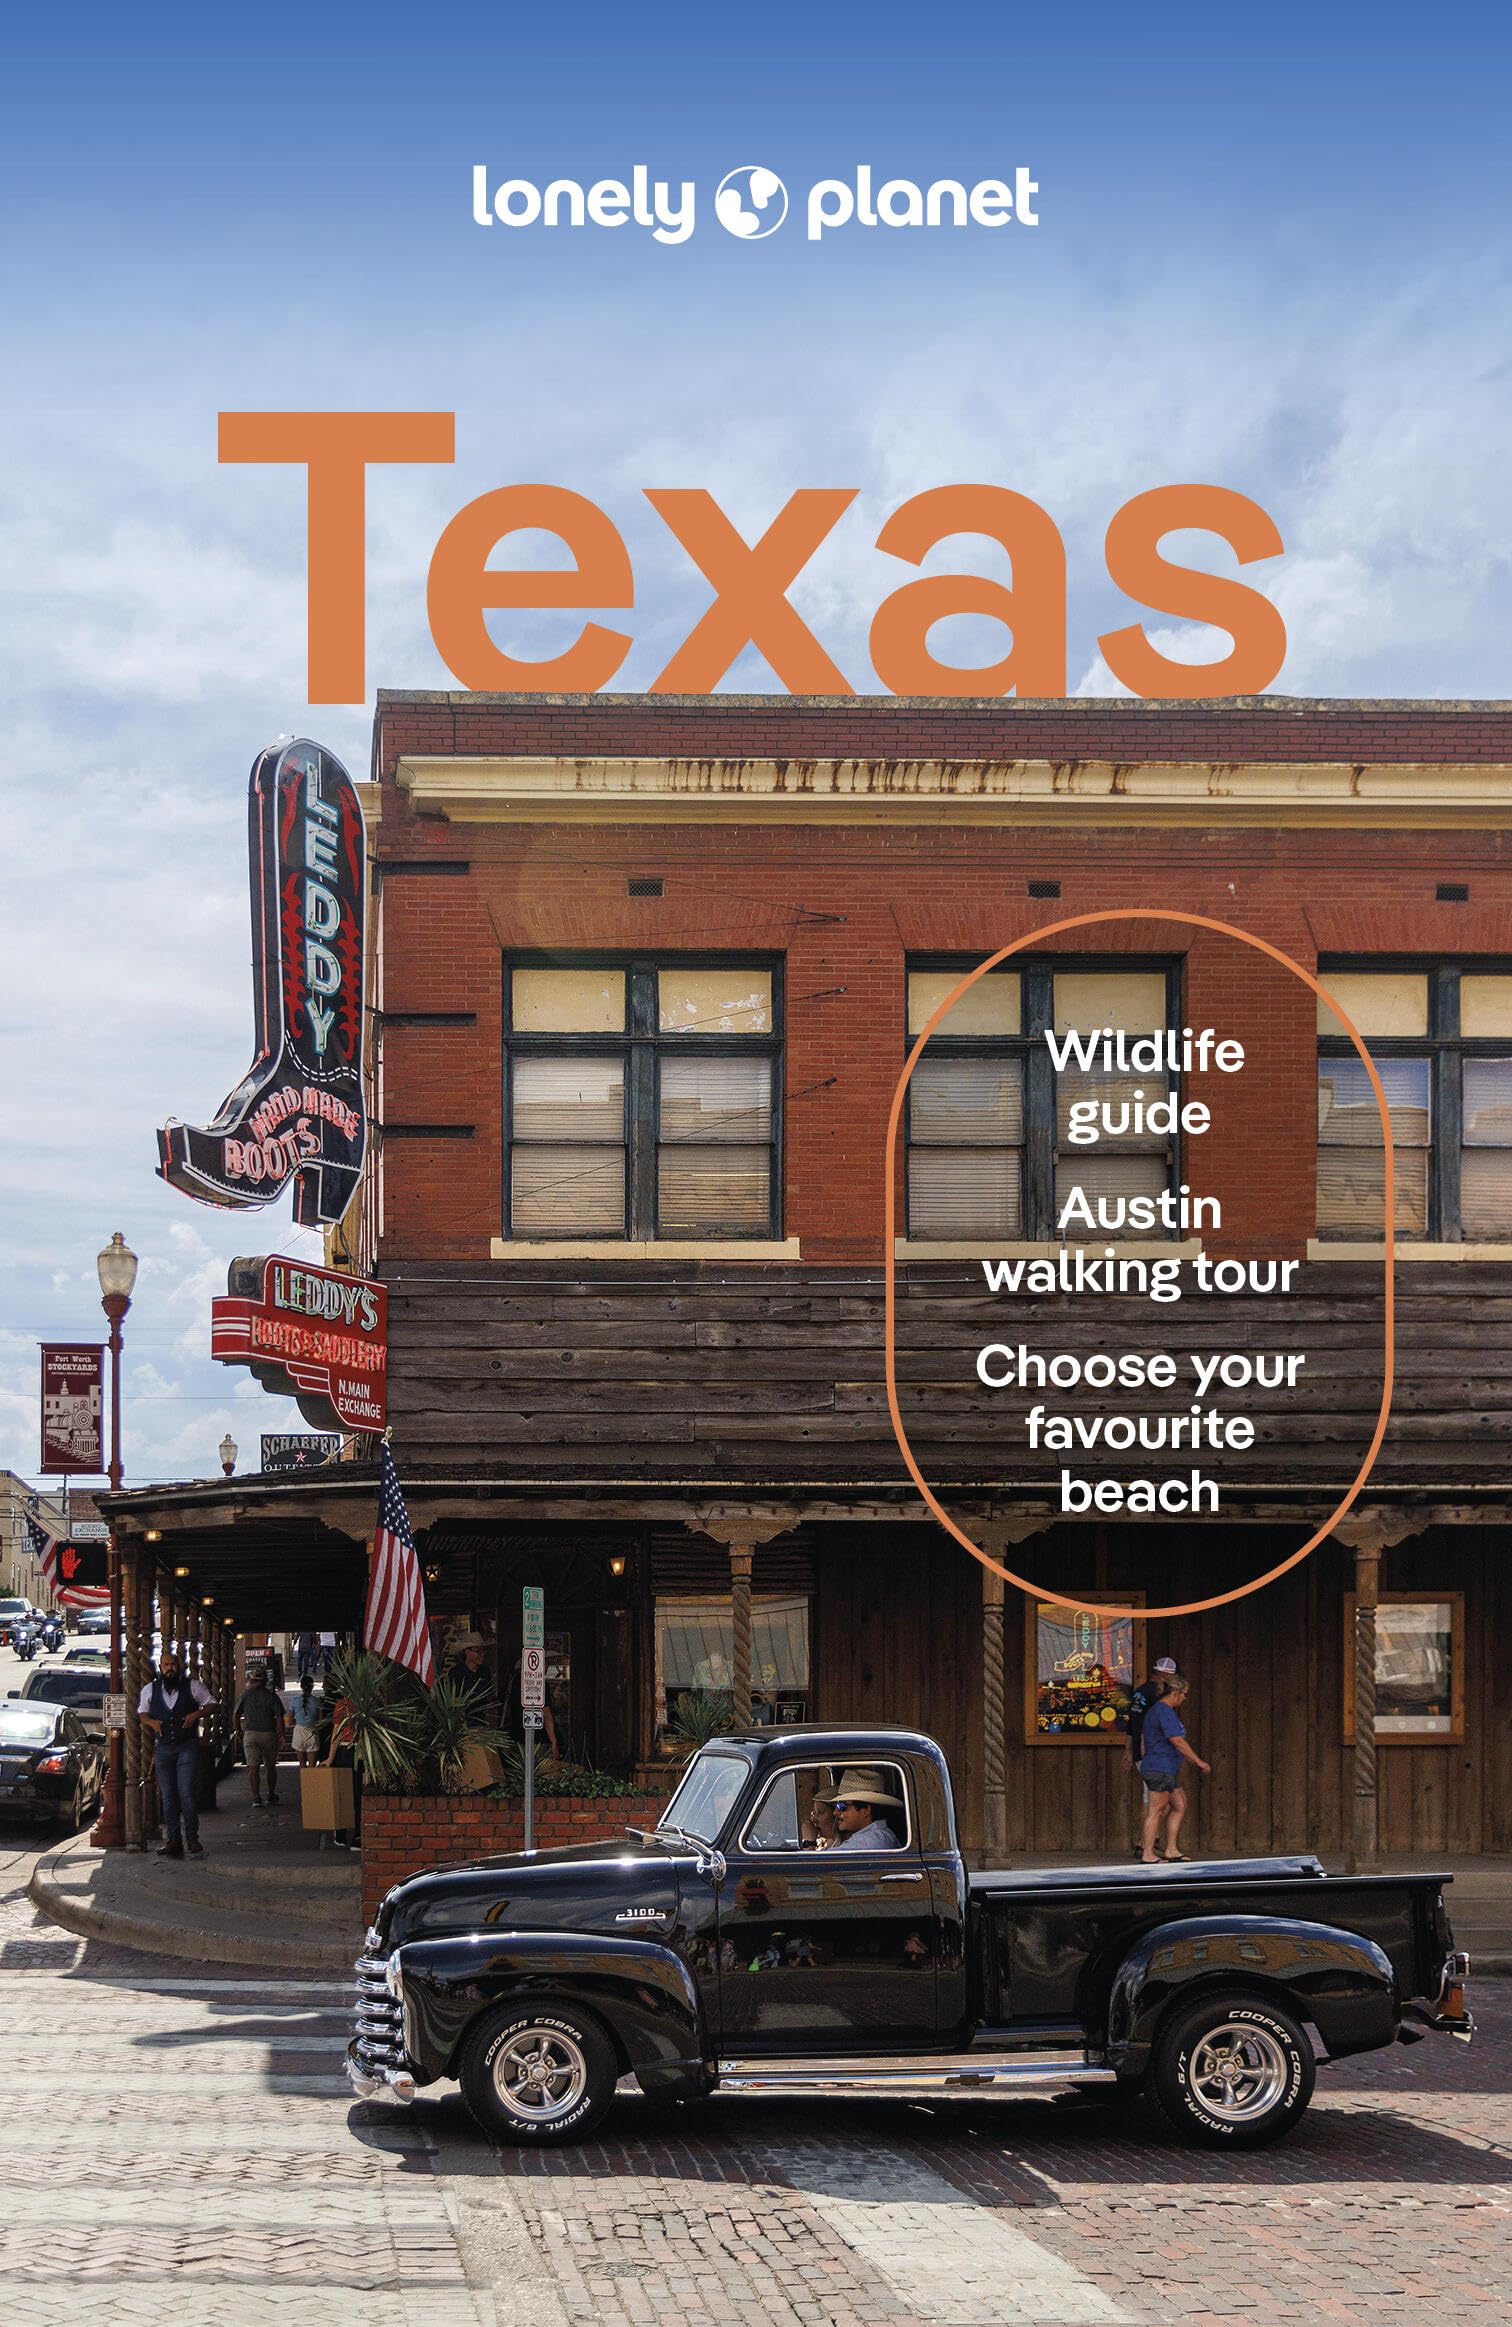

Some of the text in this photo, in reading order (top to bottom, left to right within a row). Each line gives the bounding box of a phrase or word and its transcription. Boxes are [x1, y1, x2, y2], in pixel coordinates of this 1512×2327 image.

[304, 760, 342, 1056] LEDDY
[224, 1117, 321, 1185] BOOTS
[274, 1264, 379, 1332] LEDDY'S
[48, 1363, 98, 1371] STOCKYARDS
[72, 1355, 92, 1363] Worth
[338, 1401, 382, 1419] EXCHANGE
[626, 1908, 655, 1917] 3100
[484, 2017, 583, 2067] COOPER COBRA
[1228, 2010, 1301, 2108] COOPER COBRA
[508, 2096, 592, 2131] RADIAL G/T
[1177, 2051, 1234, 2134] RADIAL G/T
